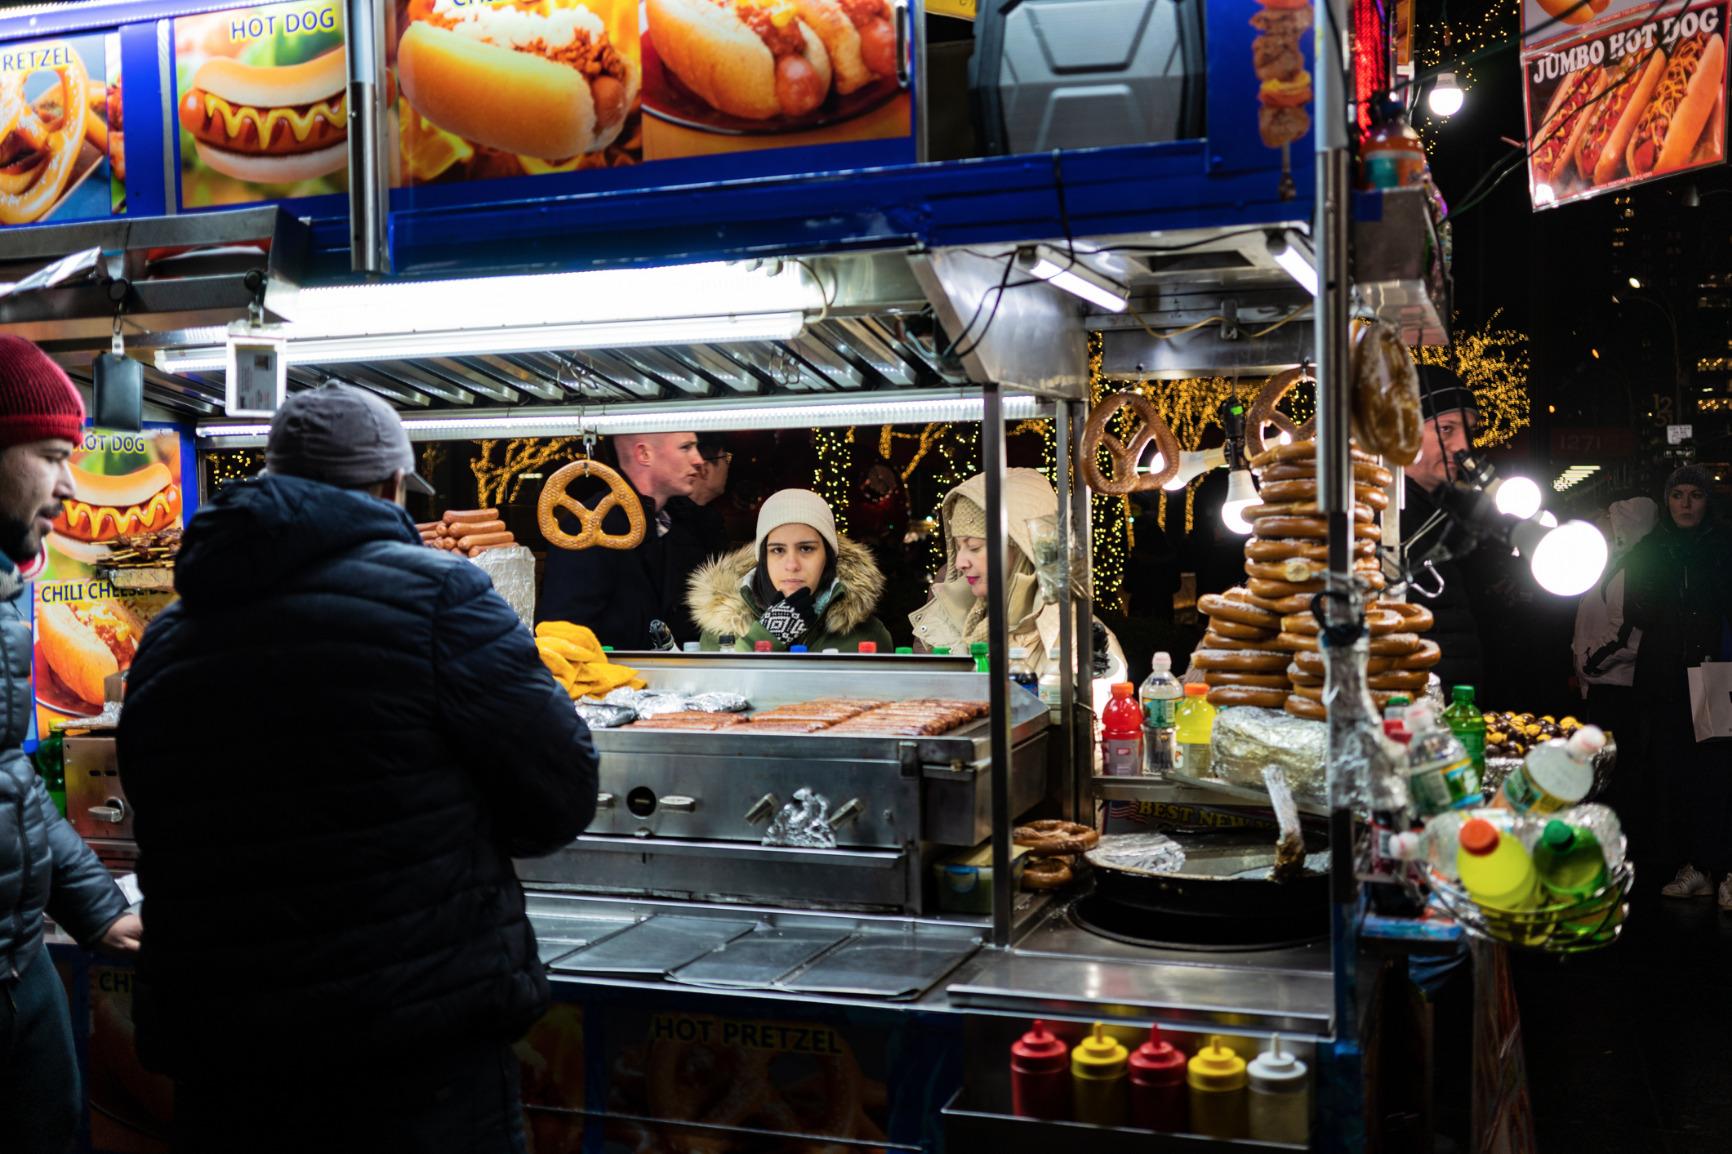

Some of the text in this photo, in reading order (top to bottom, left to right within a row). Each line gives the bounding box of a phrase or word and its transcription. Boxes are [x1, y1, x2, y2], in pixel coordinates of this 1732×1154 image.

[231, 8, 335, 39] HOT DOG
[1533, 40, 1605, 83] JUMBO
[1609, 23, 1658, 59] HOT
[1662, 7, 1720, 44] DOG
[80, 434, 145, 452] OT DOG
[41, 584, 83, 603] CHILI
[1138, 801, 1194, 821] BEST
[1200, 810, 1249, 829] NEW
[656, 1017, 843, 1053] HOT PRETZEL
